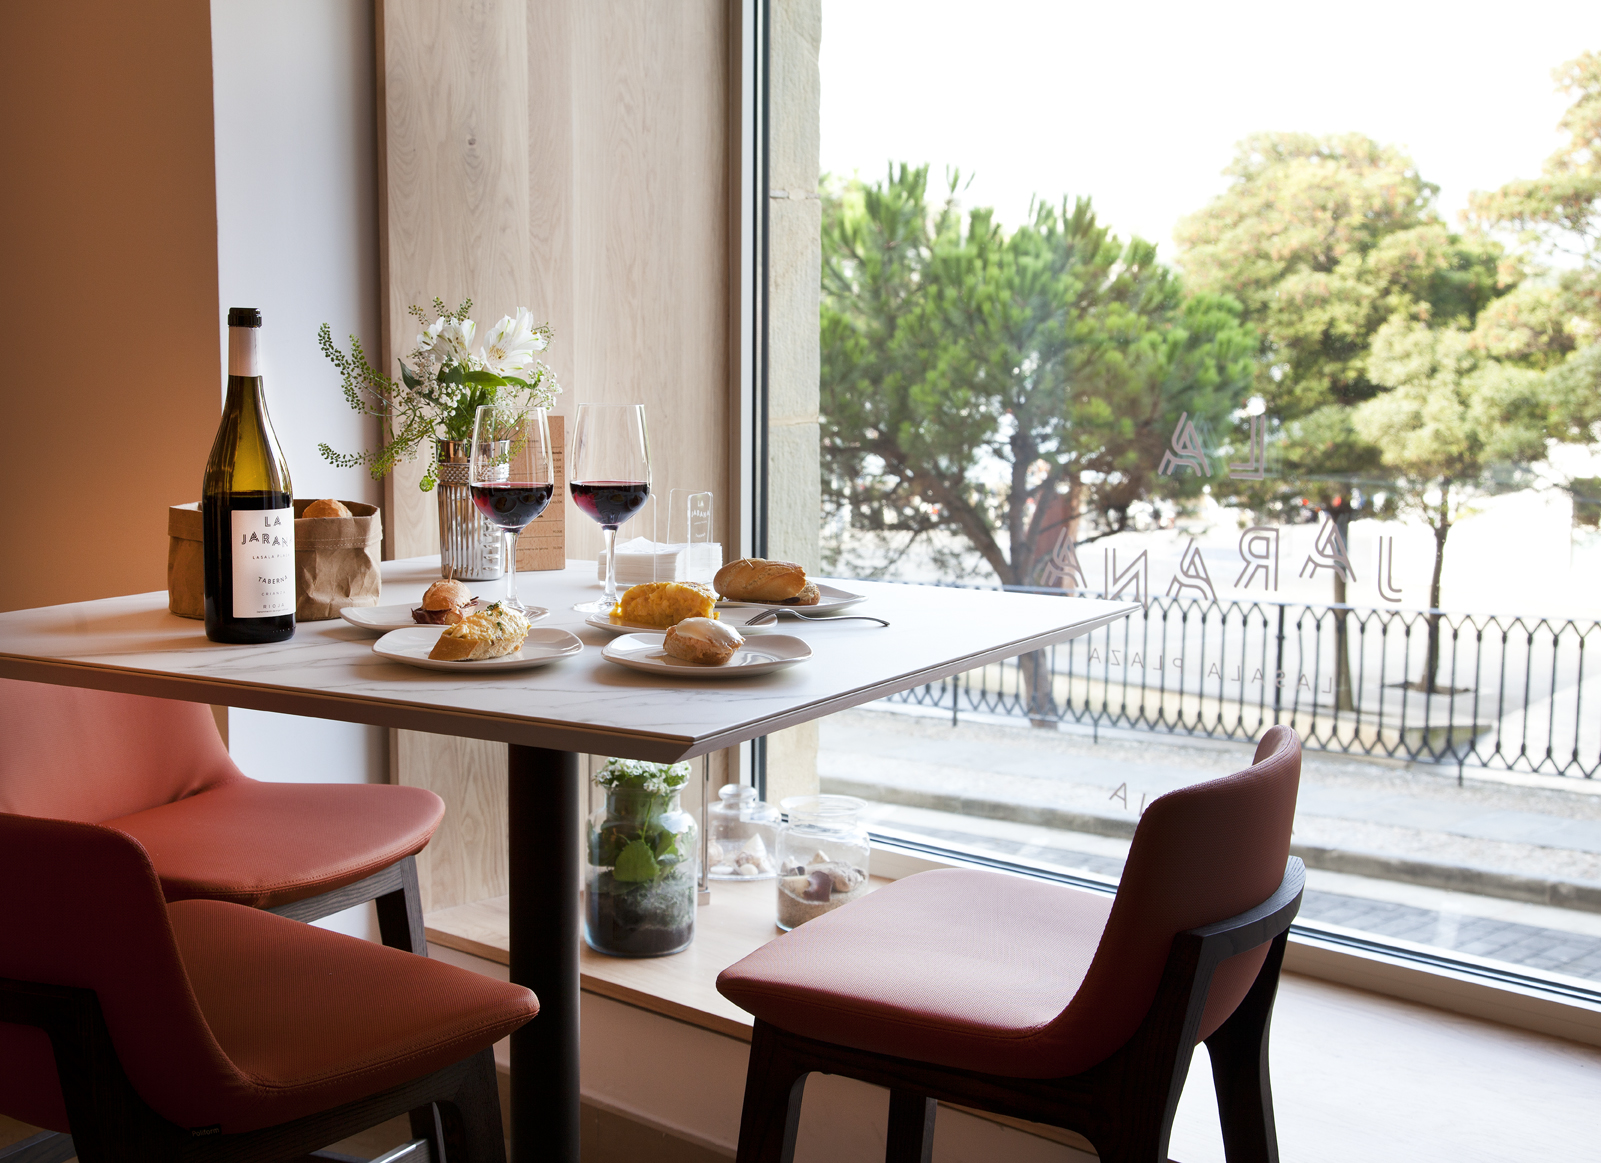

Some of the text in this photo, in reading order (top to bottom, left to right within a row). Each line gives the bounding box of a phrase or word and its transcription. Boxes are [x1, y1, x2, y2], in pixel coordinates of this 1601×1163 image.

[265, 516, 281, 527] LA
[258, 575, 288, 584] TABERNA
[191, 1128, 220, 1137] Poliform
